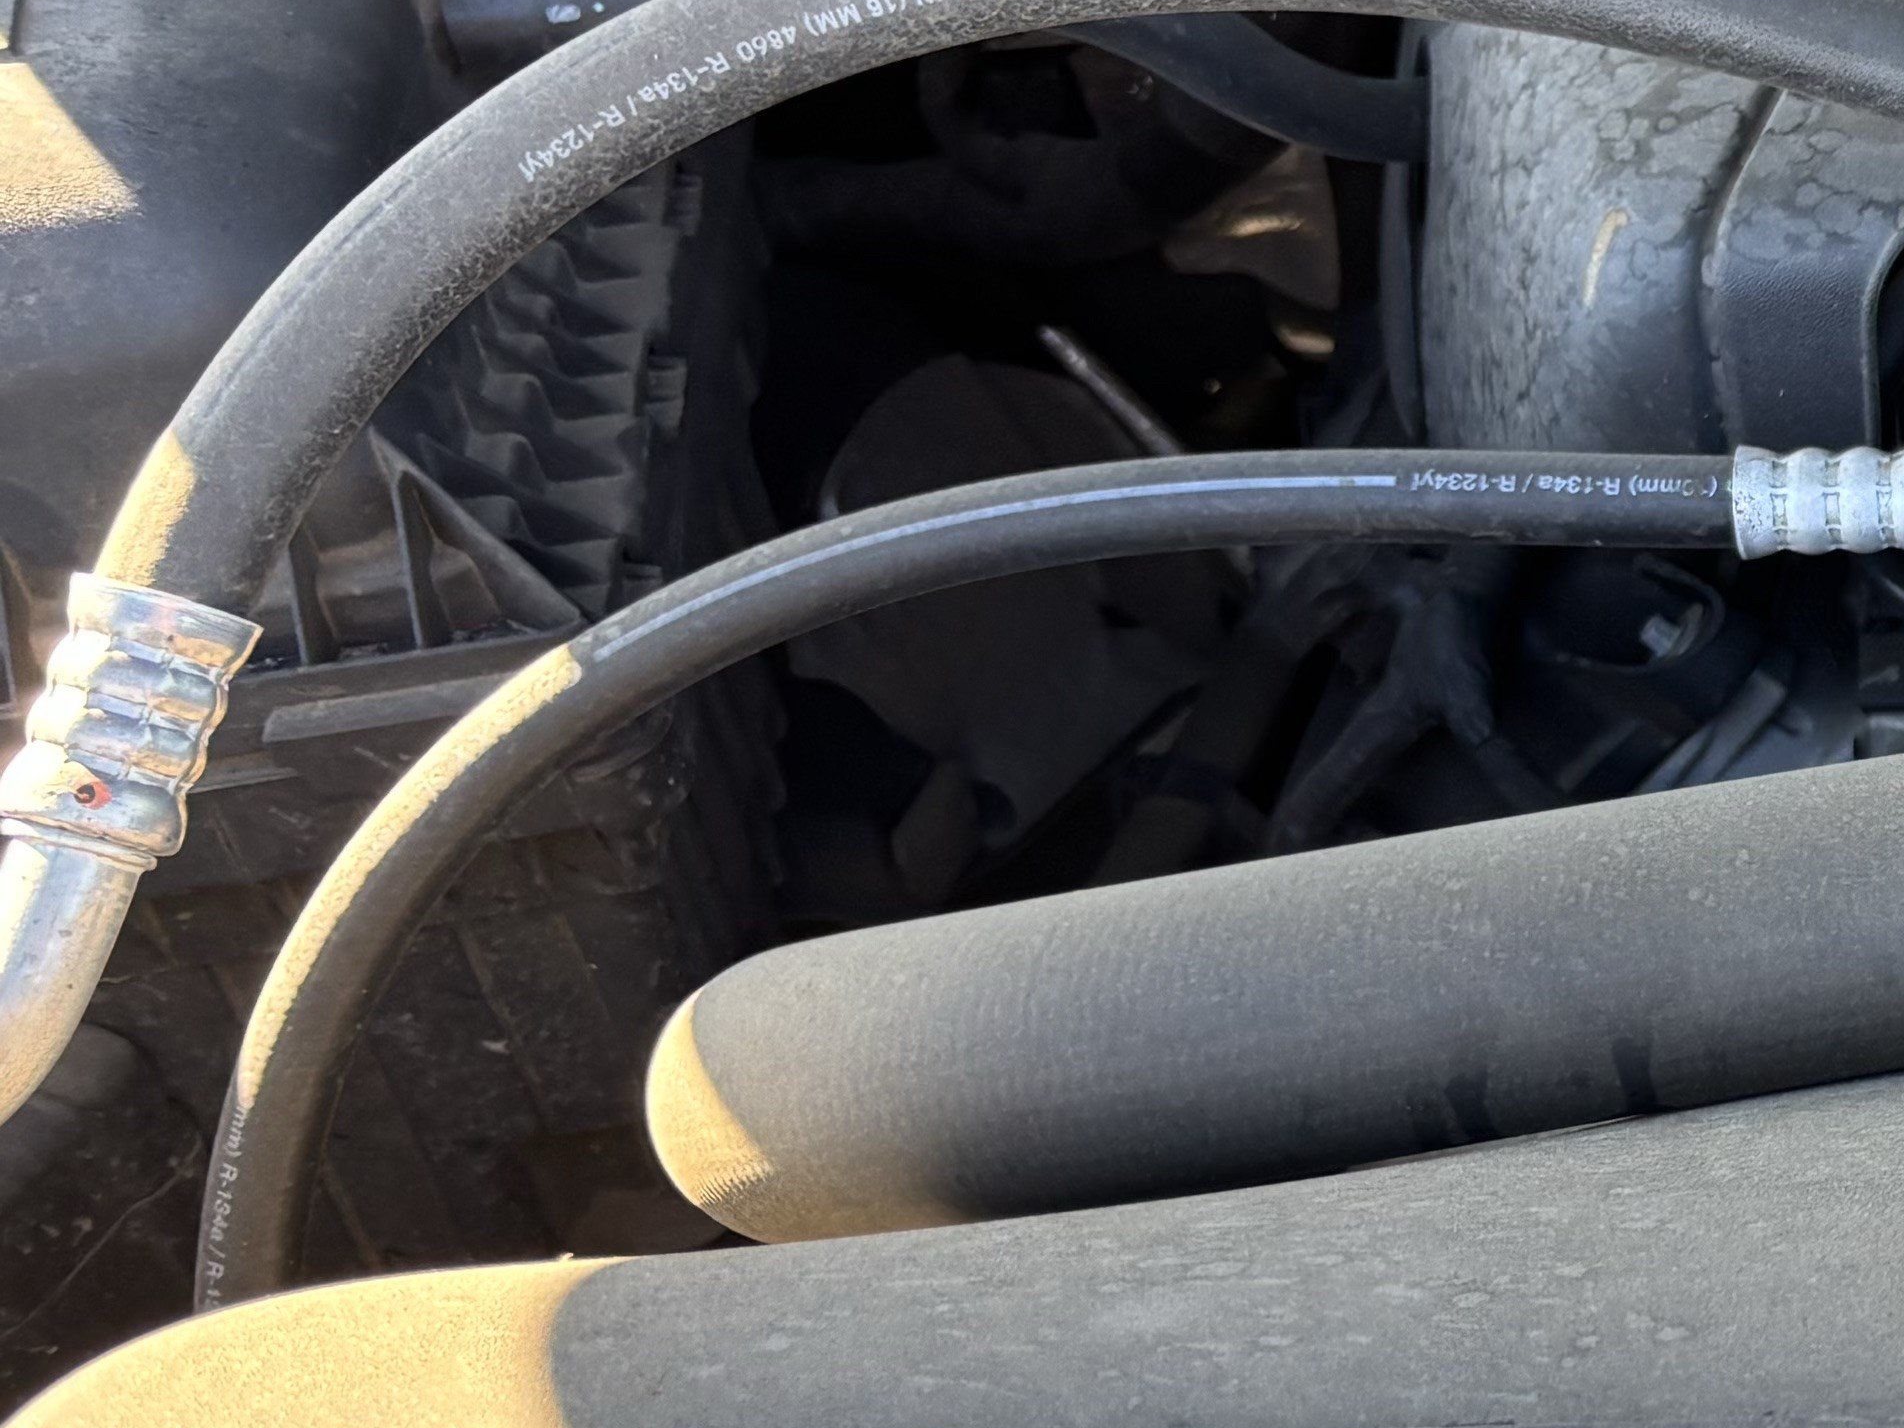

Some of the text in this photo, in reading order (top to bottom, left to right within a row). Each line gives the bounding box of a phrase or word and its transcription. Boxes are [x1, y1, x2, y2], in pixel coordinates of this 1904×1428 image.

[803, 3, 862, 37] MM)
[736, 25, 798, 63] 4860
[637, 52, 732, 104] R-134a
[517, 104, 627, 184] R-1234yf
[1409, 468, 1517, 493] R-1234yf
[1538, 474, 1621, 497] R-134a
